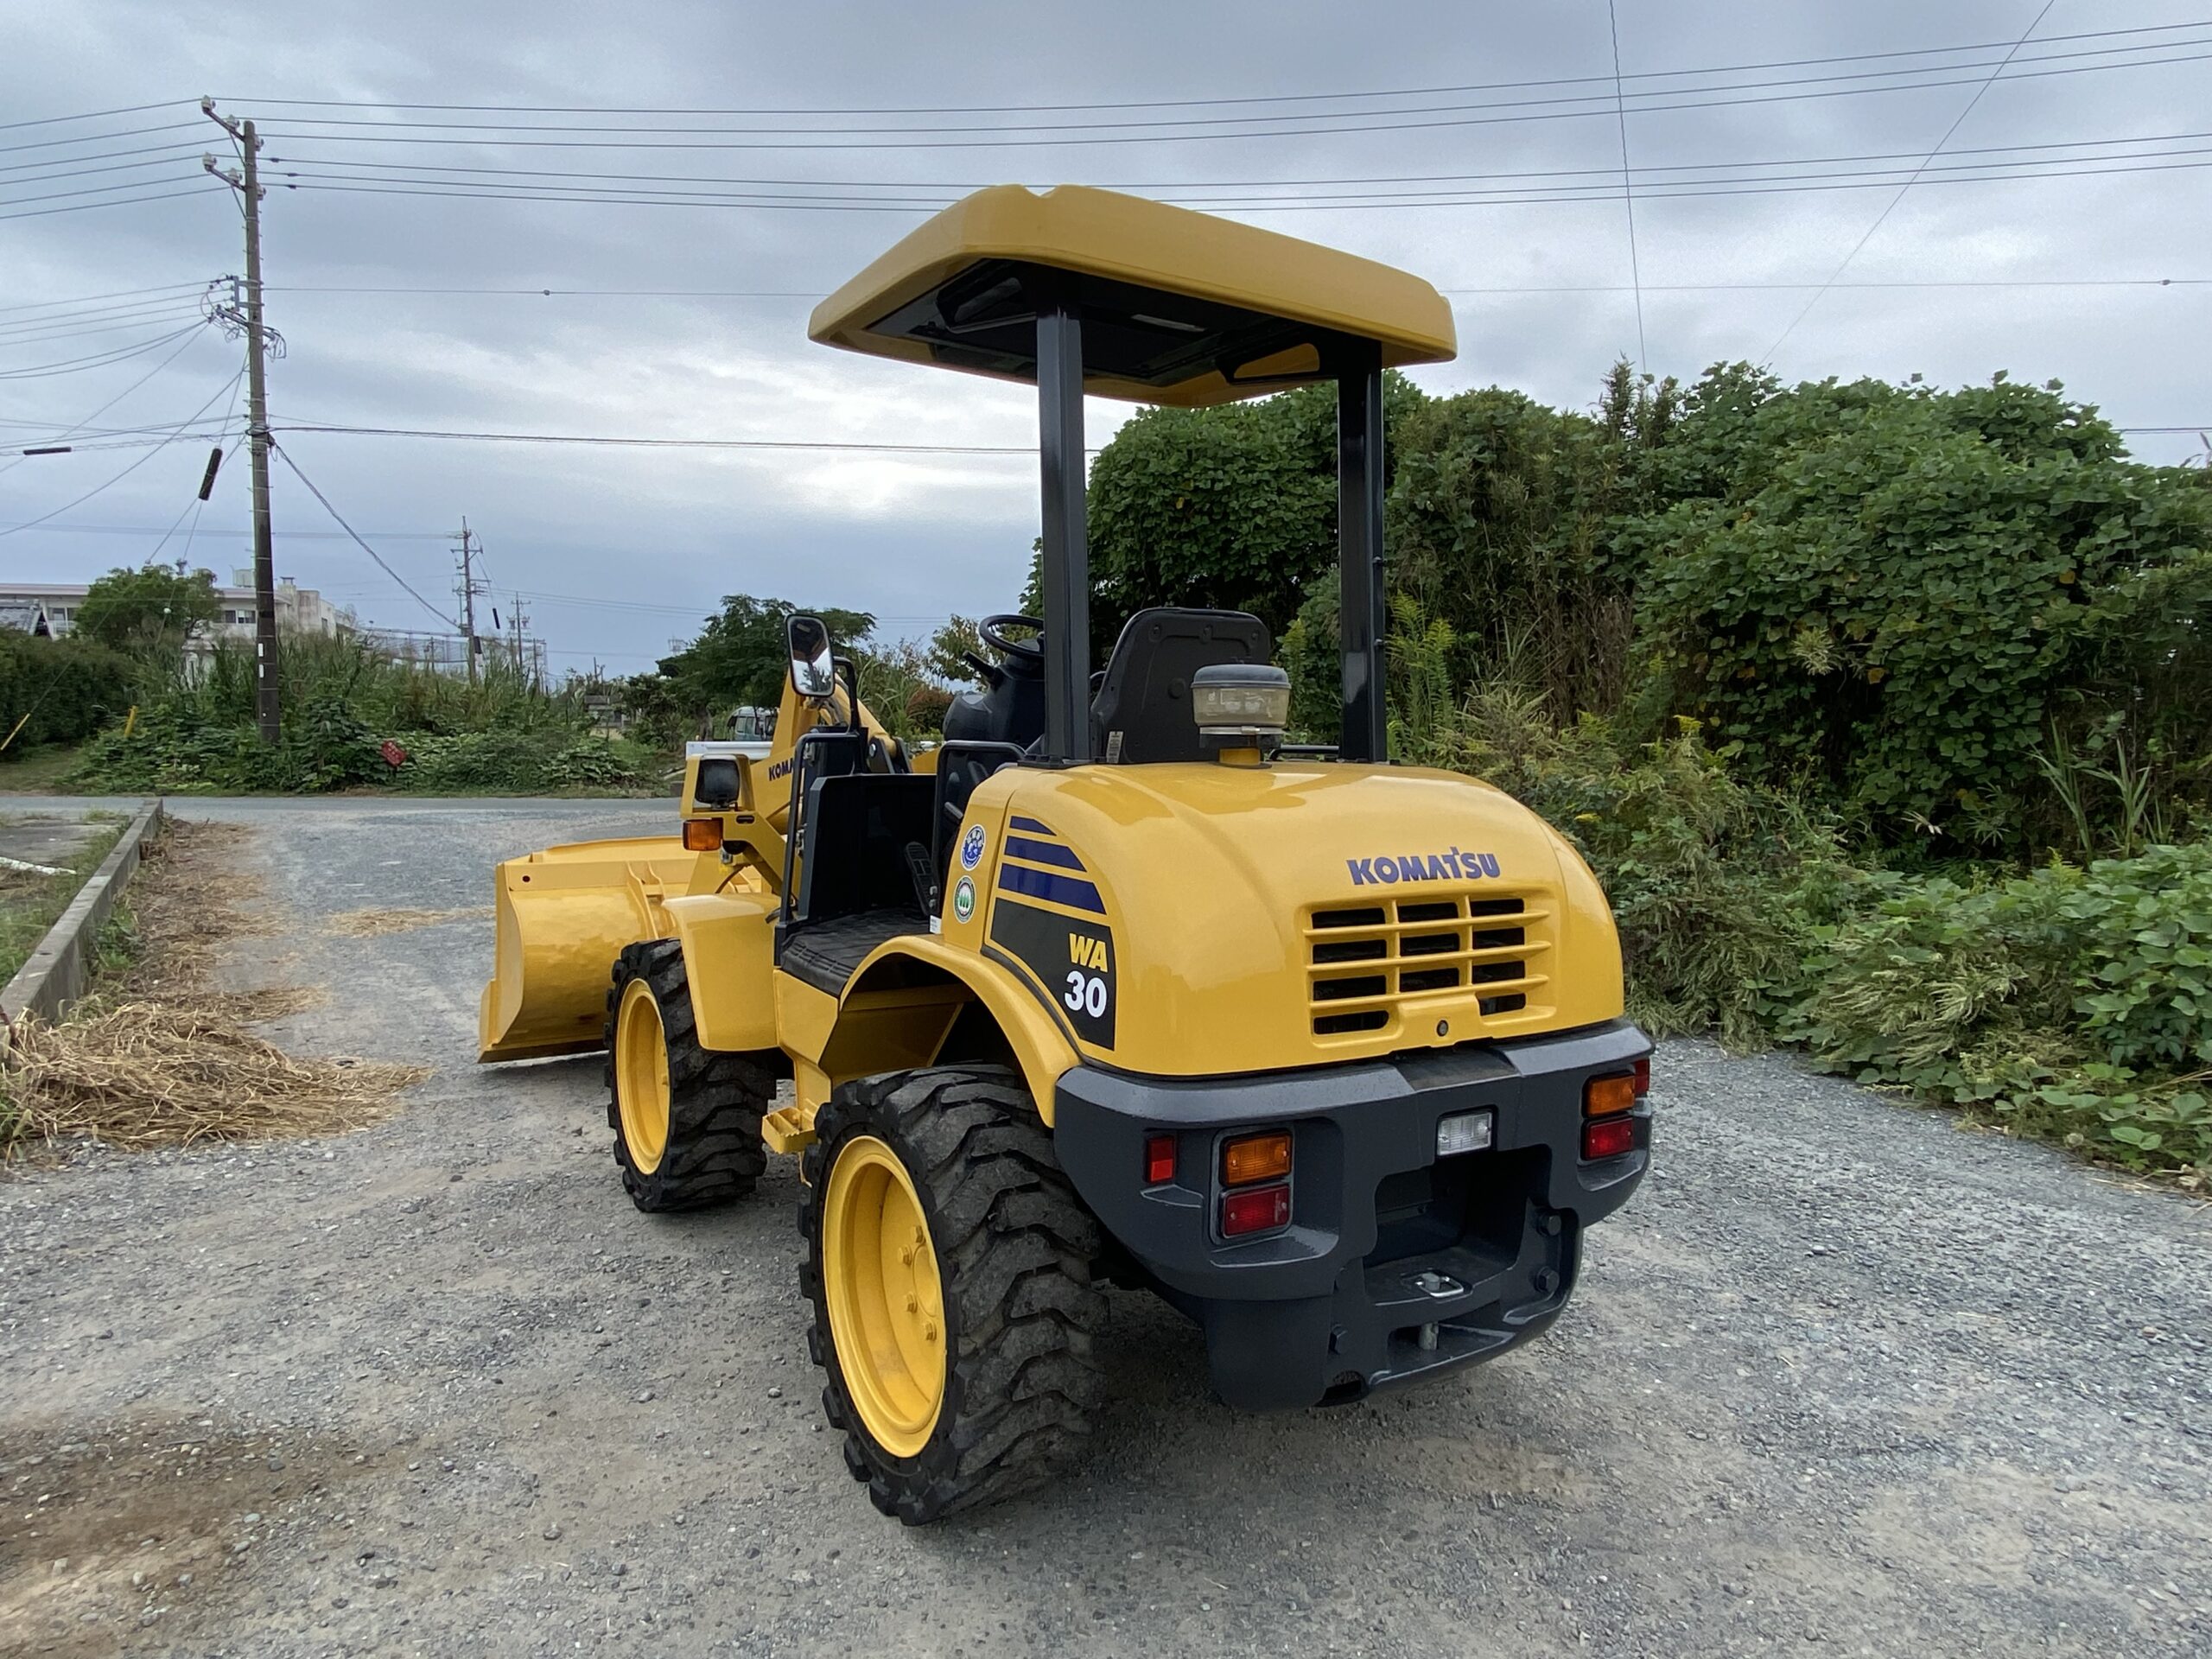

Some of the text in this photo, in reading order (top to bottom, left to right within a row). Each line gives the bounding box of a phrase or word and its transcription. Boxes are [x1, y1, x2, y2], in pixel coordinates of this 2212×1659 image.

[1346, 846, 1501, 885] KOMATSU
[1069, 932, 1109, 973] WA
[1065, 970, 1107, 1018] 30
